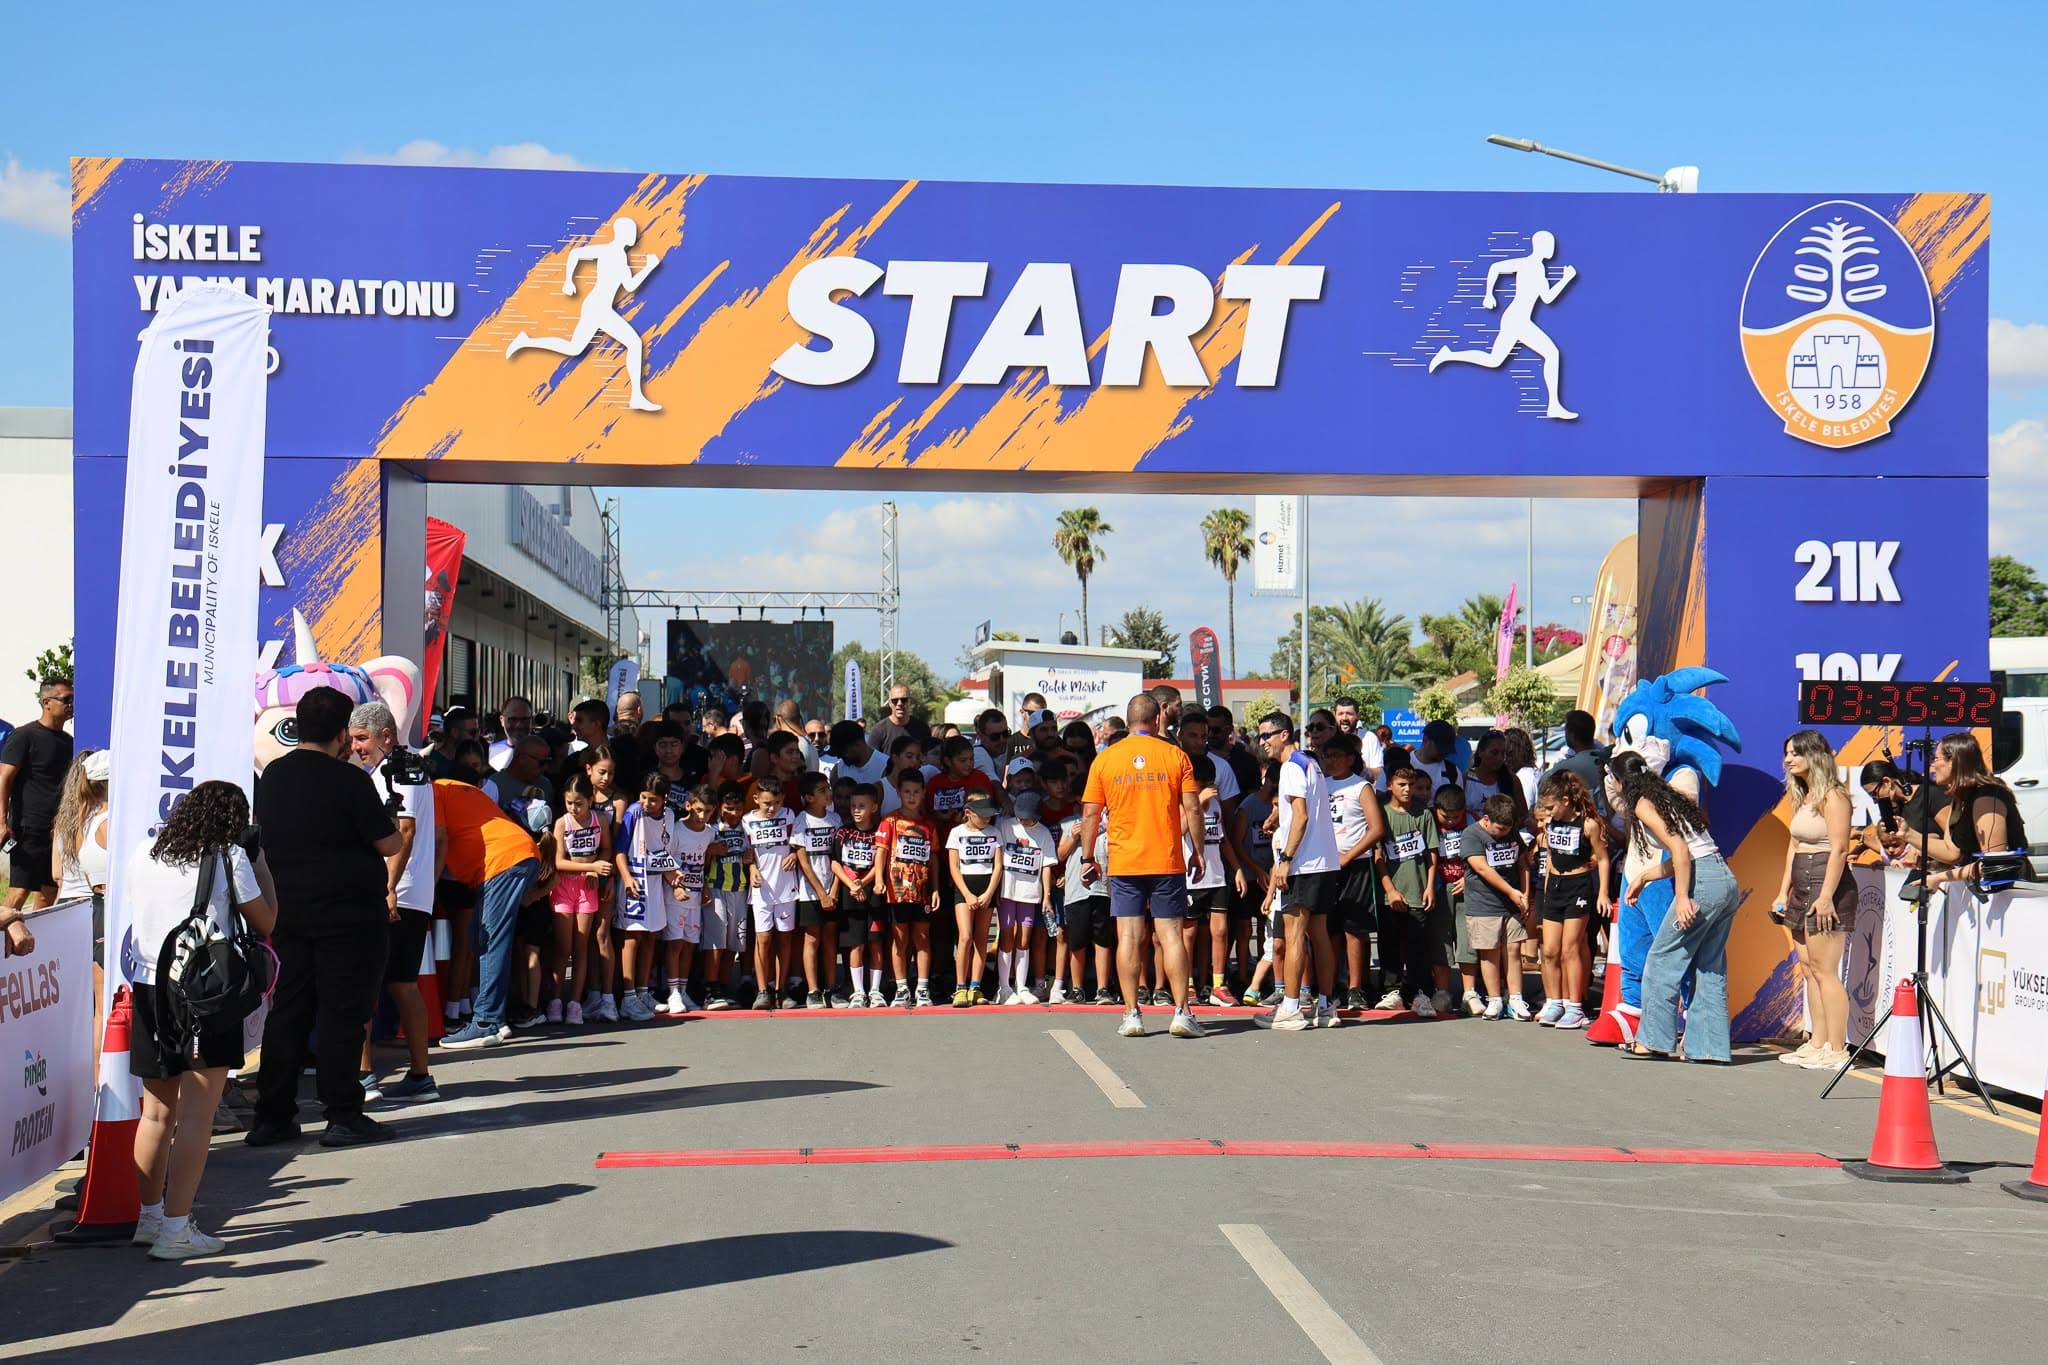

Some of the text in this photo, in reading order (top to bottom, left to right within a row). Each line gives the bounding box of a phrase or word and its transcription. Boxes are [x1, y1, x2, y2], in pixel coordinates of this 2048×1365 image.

[133, 213, 261, 262] İSKELE
[257, 277, 455, 317] MARATONU
[770, 256, 1326, 387] START
[1813, 394, 1862, 410] 1958
[168, 339, 215, 649] BELEDİYESİ
[207, 551, 218, 574] OF
[1794, 540, 1902, 602] 21K
[204, 577, 218, 685] MUNICIPALITY
[1808, 684, 1997, 723] 03:35:32
[756, 829, 783, 840] 2543
[1550, 834, 1572, 846] 2361
[965, 845, 991, 856] 2067
[1393, 840, 1419, 854] 2497
[651, 858, 675, 868] 2400
[1011, 854, 1035, 867] 2261
[2015, 994, 2036, 1009] GROUP
